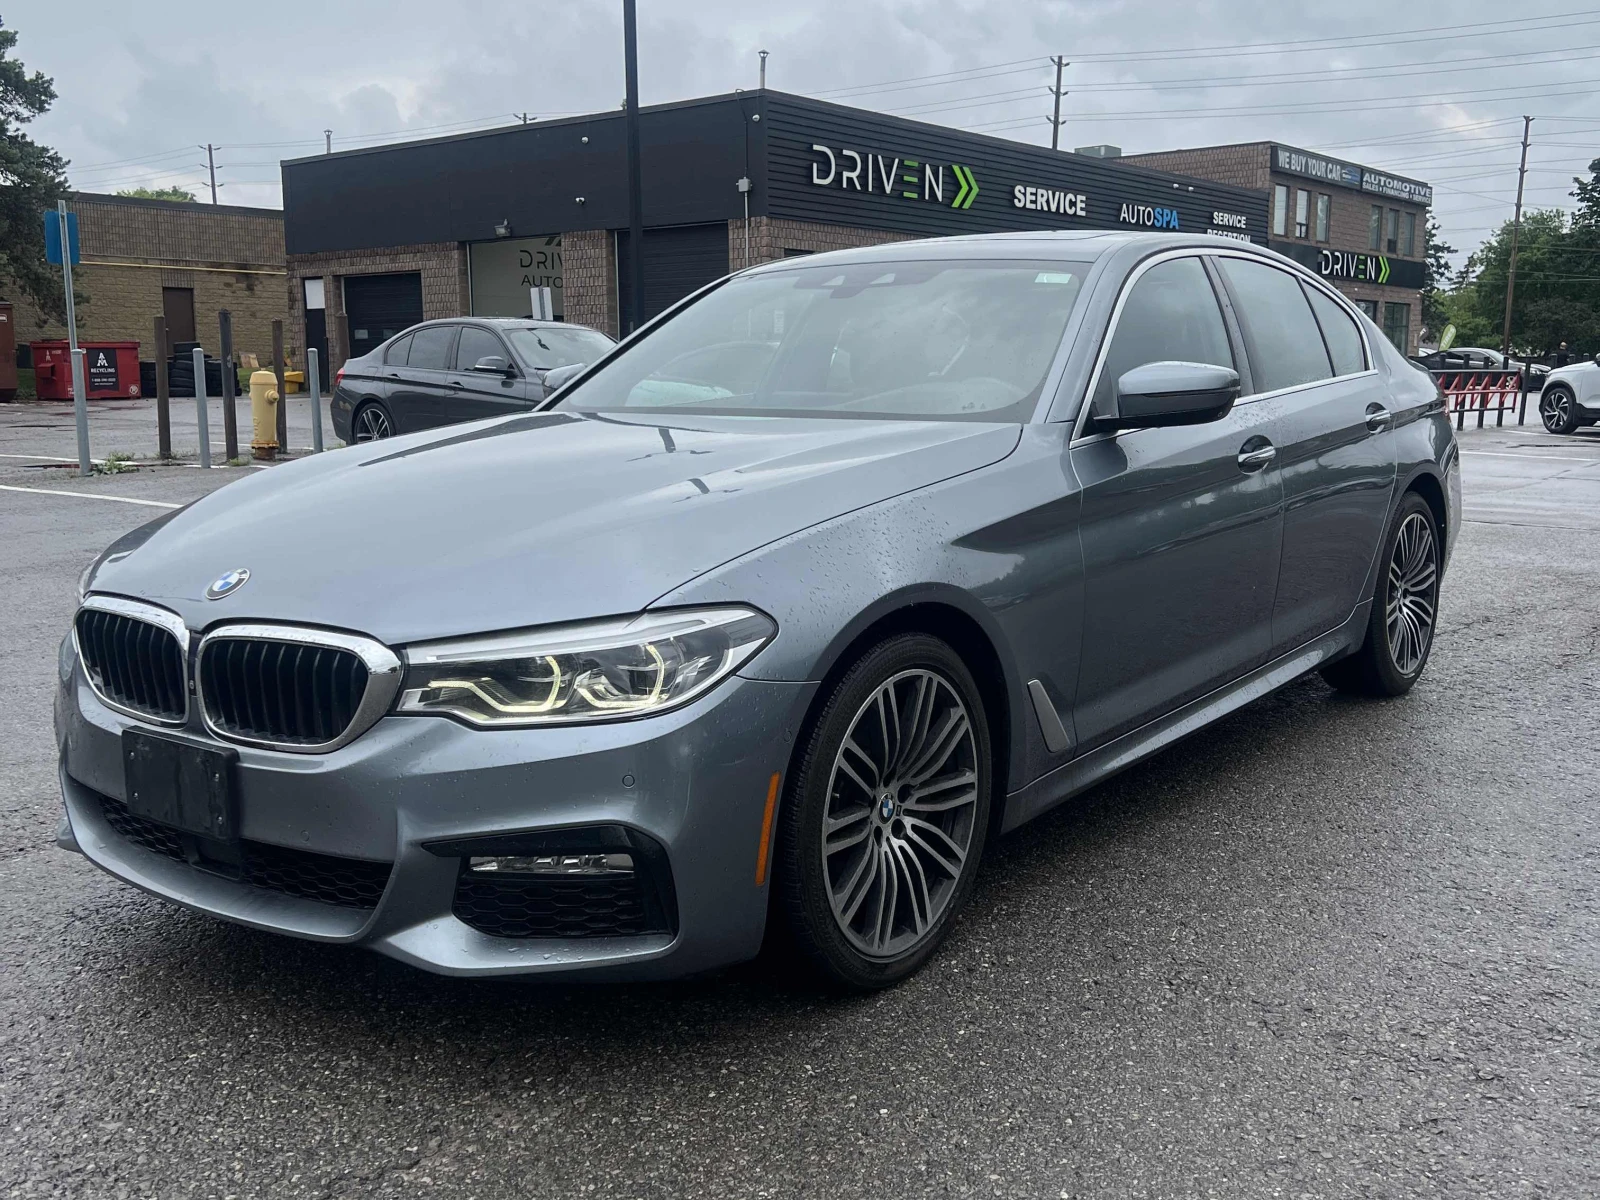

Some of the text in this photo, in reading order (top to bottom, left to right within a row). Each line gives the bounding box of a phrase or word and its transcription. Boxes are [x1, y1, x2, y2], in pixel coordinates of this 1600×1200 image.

[813, 144, 943, 202] DRIVEN
[1278, 150, 1341, 181] WE BUY YOUR CAR
[1363, 172, 1432, 197] AUTOMOTIVE
[1014, 185, 1087, 216] SERVICE
[1213, 211, 1247, 229] SERVICE
[1321, 249, 1376, 280] DRIVEN
